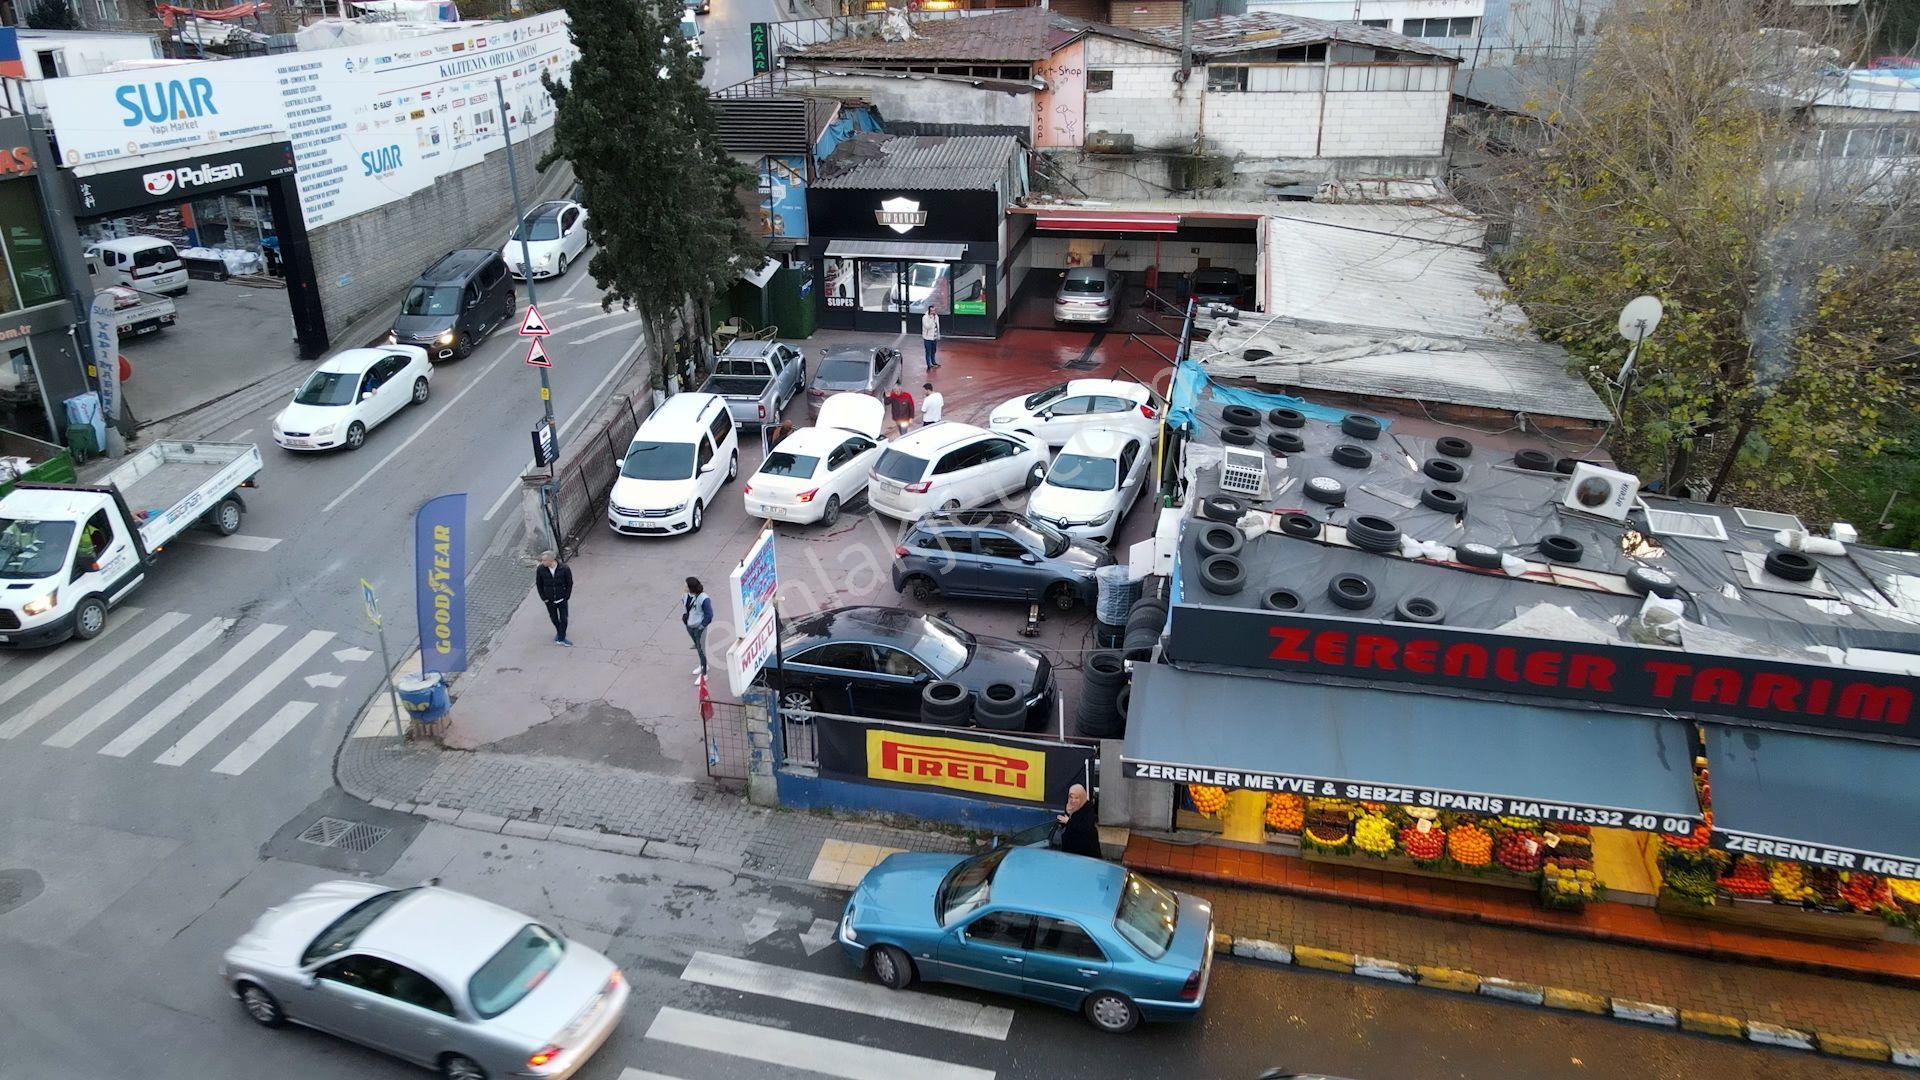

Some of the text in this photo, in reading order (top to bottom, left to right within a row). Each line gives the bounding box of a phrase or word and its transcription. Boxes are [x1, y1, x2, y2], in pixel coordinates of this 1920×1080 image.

[753, 25, 765, 69] AKTAR
[115, 77, 219, 127] SUAR
[170, 120, 198, 131] Market
[175, 162, 244, 189] Polisan
[360, 144, 402, 177] SUAR
[827, 297, 854, 307] SLOPES
[428, 524, 456, 656] GOODYEAR
[1268, 626, 1915, 725] ZERENLER TARIM
[881, 740, 1029, 789] PIRELLI
[1136, 763, 1691, 835] ZERENLER MEYVE & SEBZE SİPARİŞ HATTI:332 40 00
[1725, 834, 1920, 880] ZERENLER KRE
